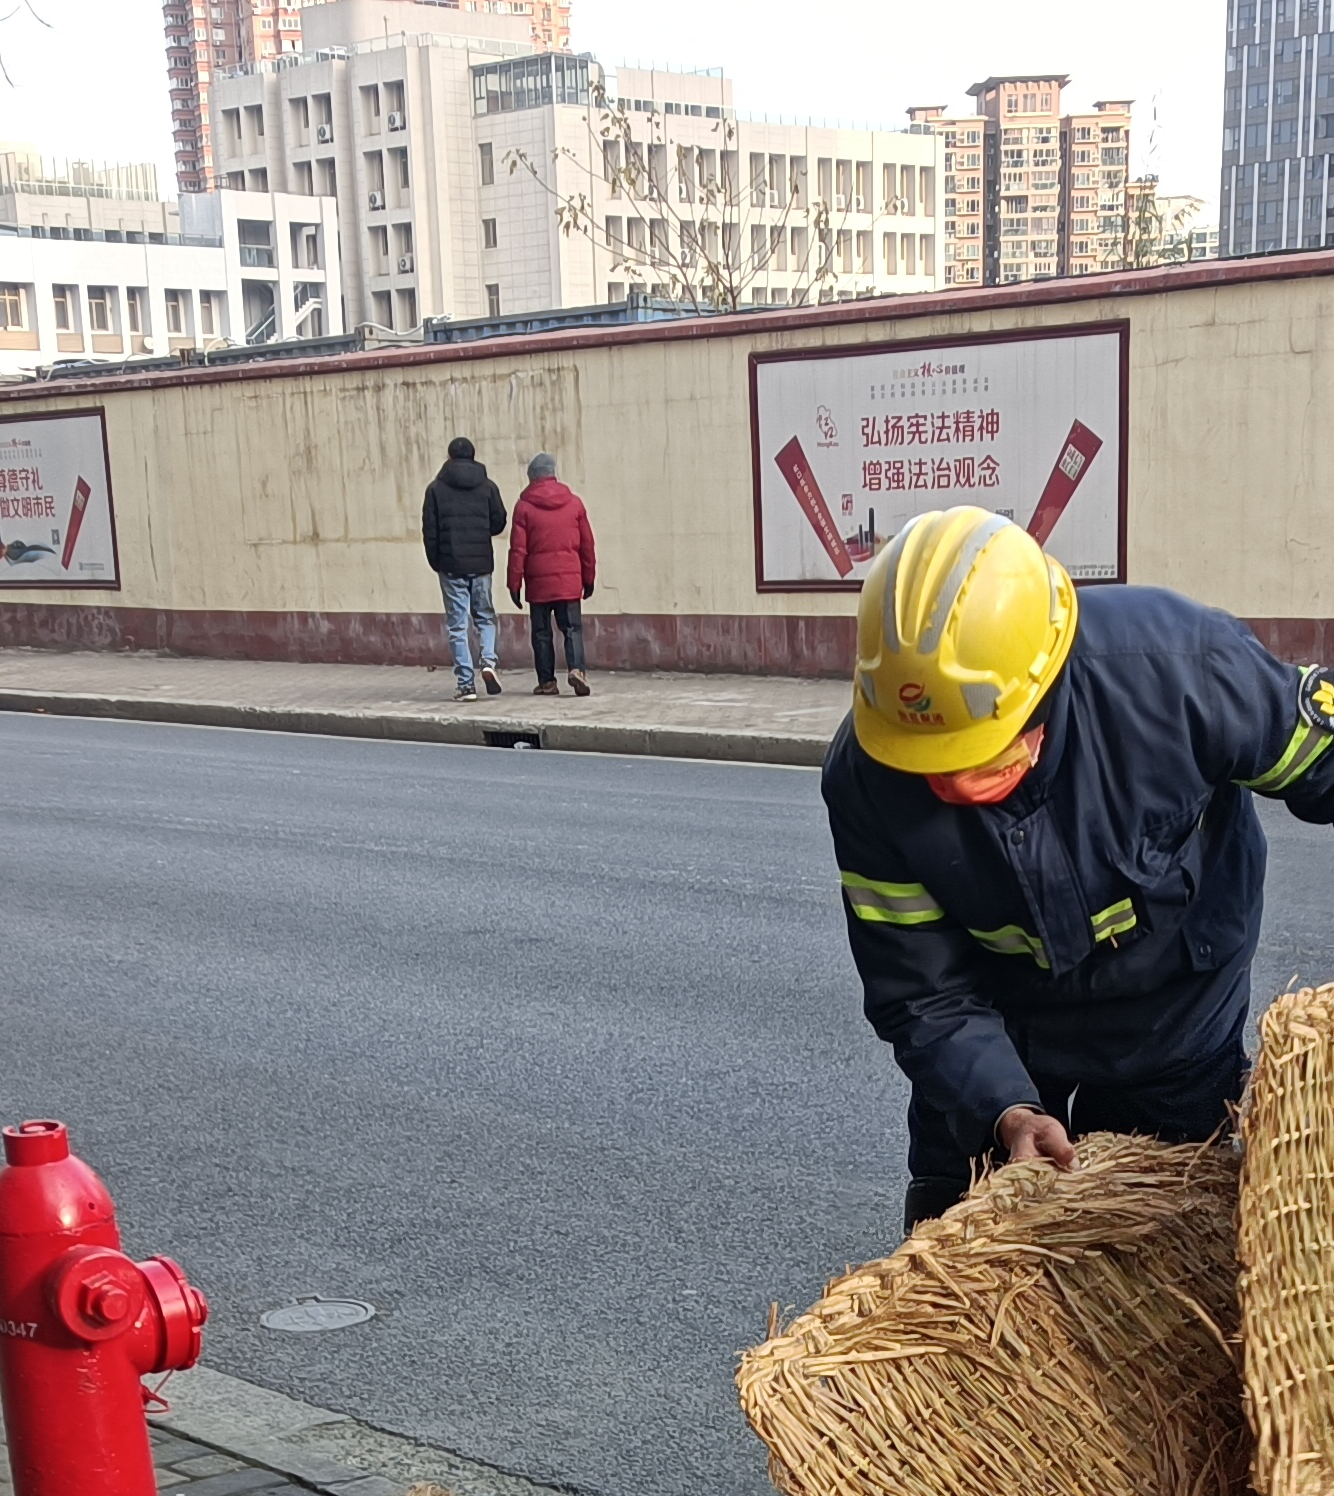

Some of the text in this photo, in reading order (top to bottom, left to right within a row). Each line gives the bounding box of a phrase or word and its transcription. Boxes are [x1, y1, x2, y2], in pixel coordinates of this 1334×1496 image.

[860, 408, 1000, 447] 弘扬宪法精神
[861, 454, 1001, 491] 增强法治观念
